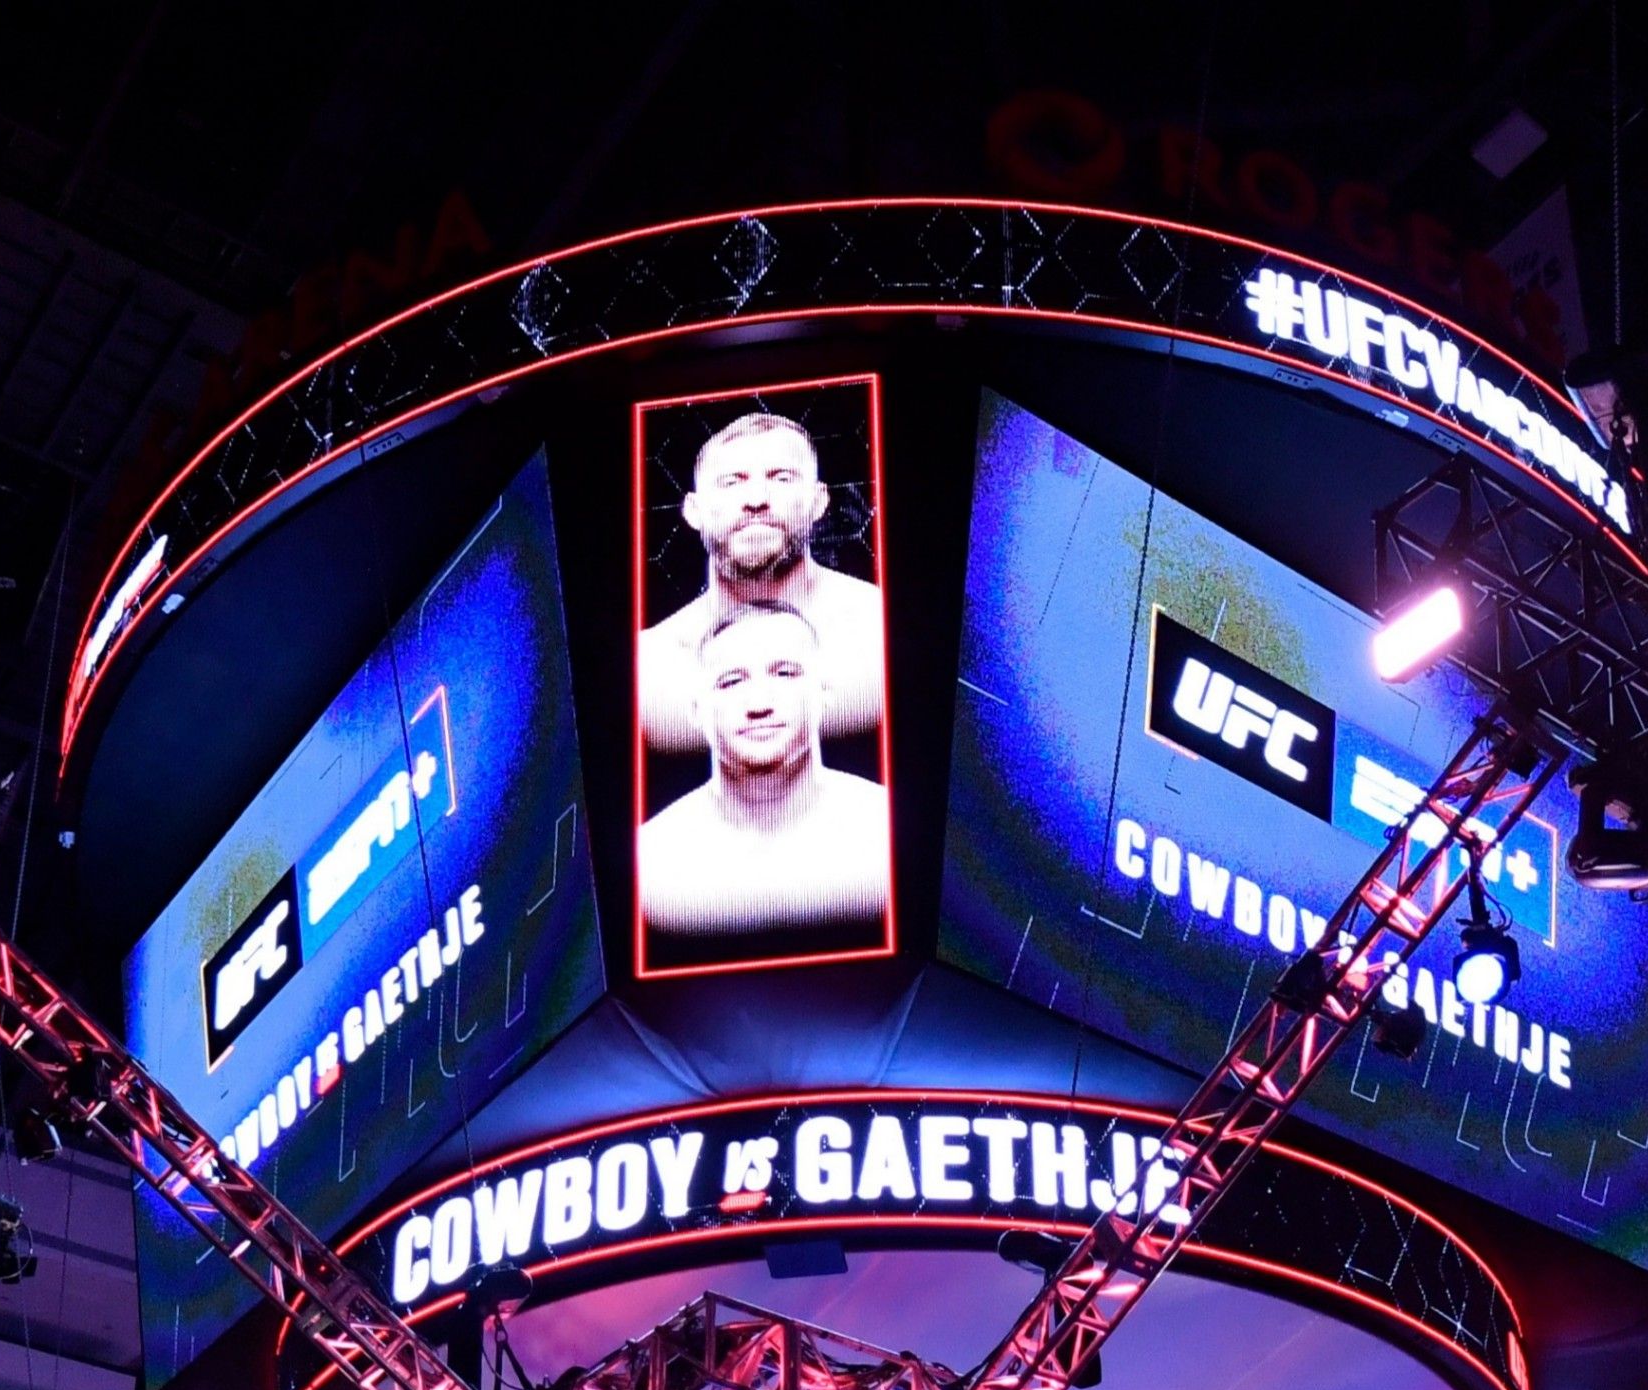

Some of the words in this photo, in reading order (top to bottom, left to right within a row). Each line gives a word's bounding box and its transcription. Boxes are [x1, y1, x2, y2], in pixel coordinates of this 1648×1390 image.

[1172, 656, 1320, 784] UFC
[214, 899, 290, 1031] UFC
[392, 1132, 704, 1305] COWBOY
[794, 1114, 1192, 1227] GAETHJE
